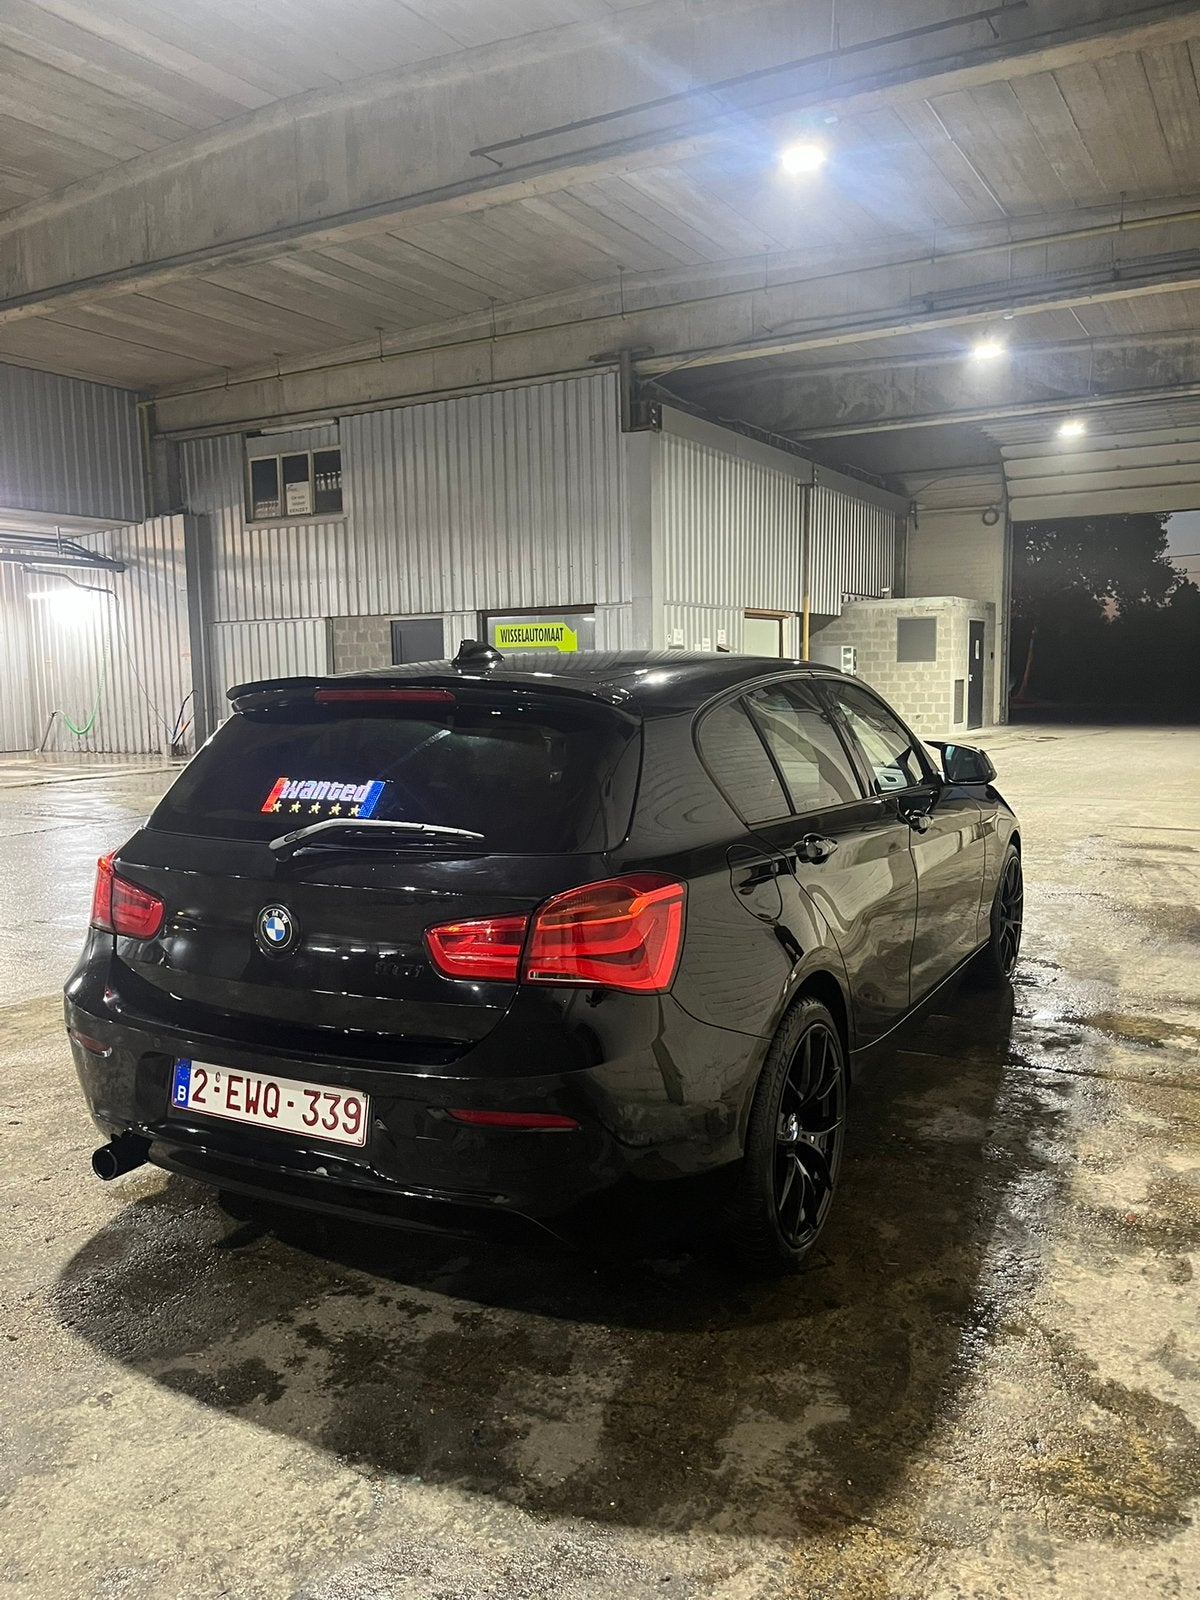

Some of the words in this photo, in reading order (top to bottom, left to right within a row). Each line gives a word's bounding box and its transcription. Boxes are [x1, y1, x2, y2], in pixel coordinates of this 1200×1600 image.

[500, 627, 564, 643] WISSELAUTOMAAT
[279, 780, 372, 802] wanted
[262, 910, 289, 924] BMW
[177, 1085, 187, 1102] B
[192, 1068, 362, 1135] 2-EWQ-339
